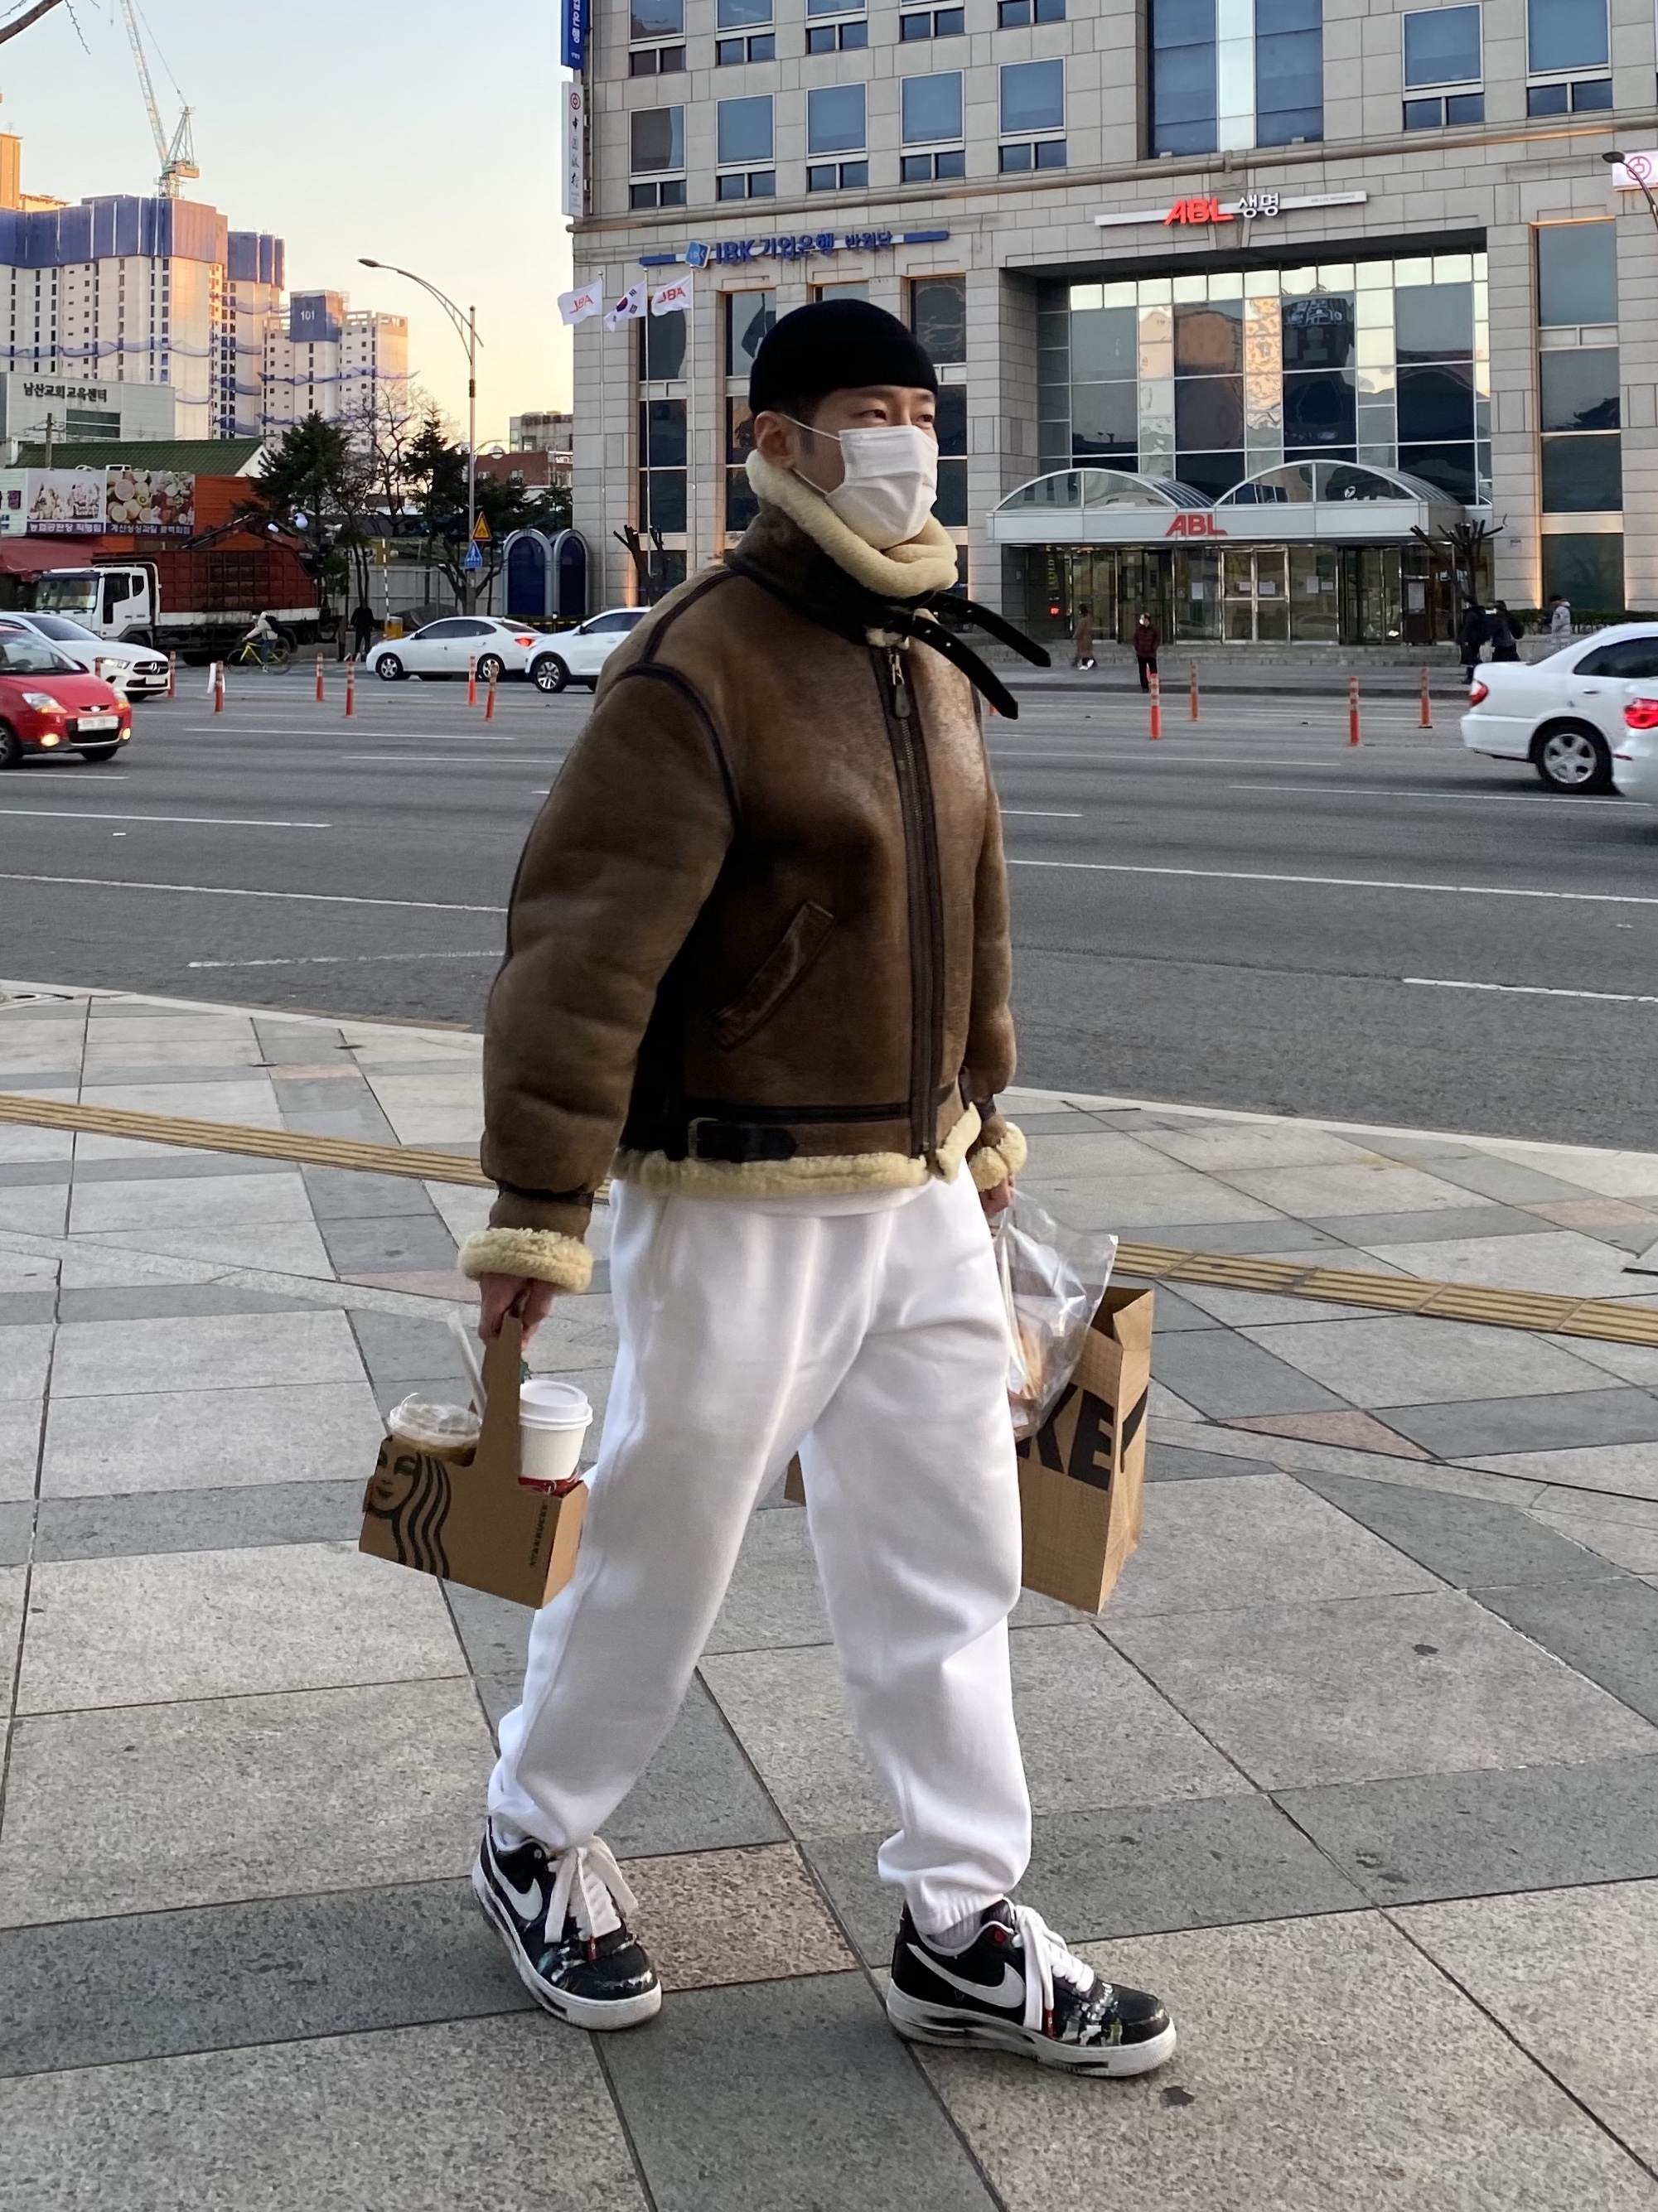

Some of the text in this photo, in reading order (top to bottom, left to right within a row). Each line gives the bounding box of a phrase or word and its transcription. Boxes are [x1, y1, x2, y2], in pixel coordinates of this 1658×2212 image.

[1163, 192, 1279, 226] ABL 생명
[300, 309, 315, 321] 101
[1166, 514, 1228, 537] ABL
